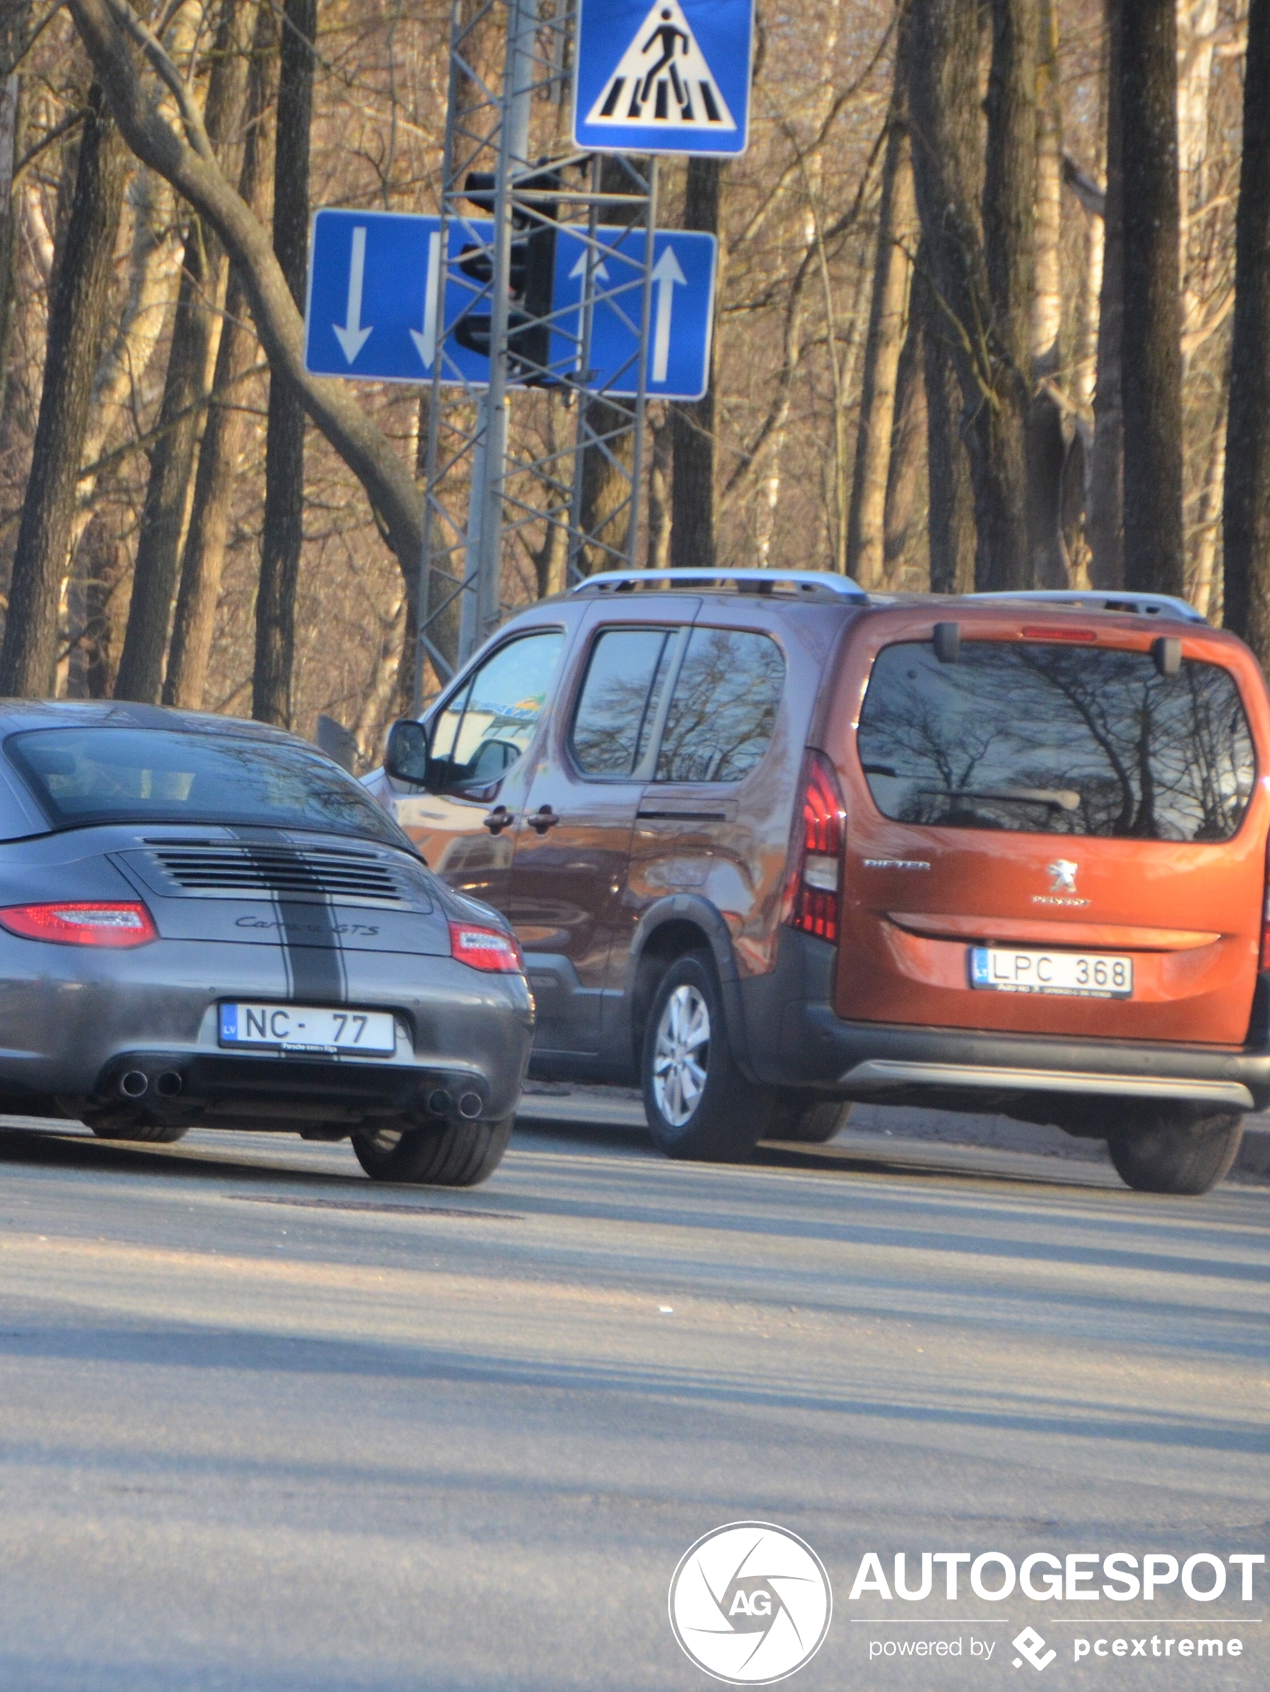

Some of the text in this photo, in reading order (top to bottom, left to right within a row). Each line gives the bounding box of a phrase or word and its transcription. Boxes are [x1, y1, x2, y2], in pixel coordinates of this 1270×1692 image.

[332, 923, 380, 936] GTS
[993, 954, 1125, 987] LPC 368
[223, 1025, 237, 1035] LV
[332, 1013, 368, 1043] 77
